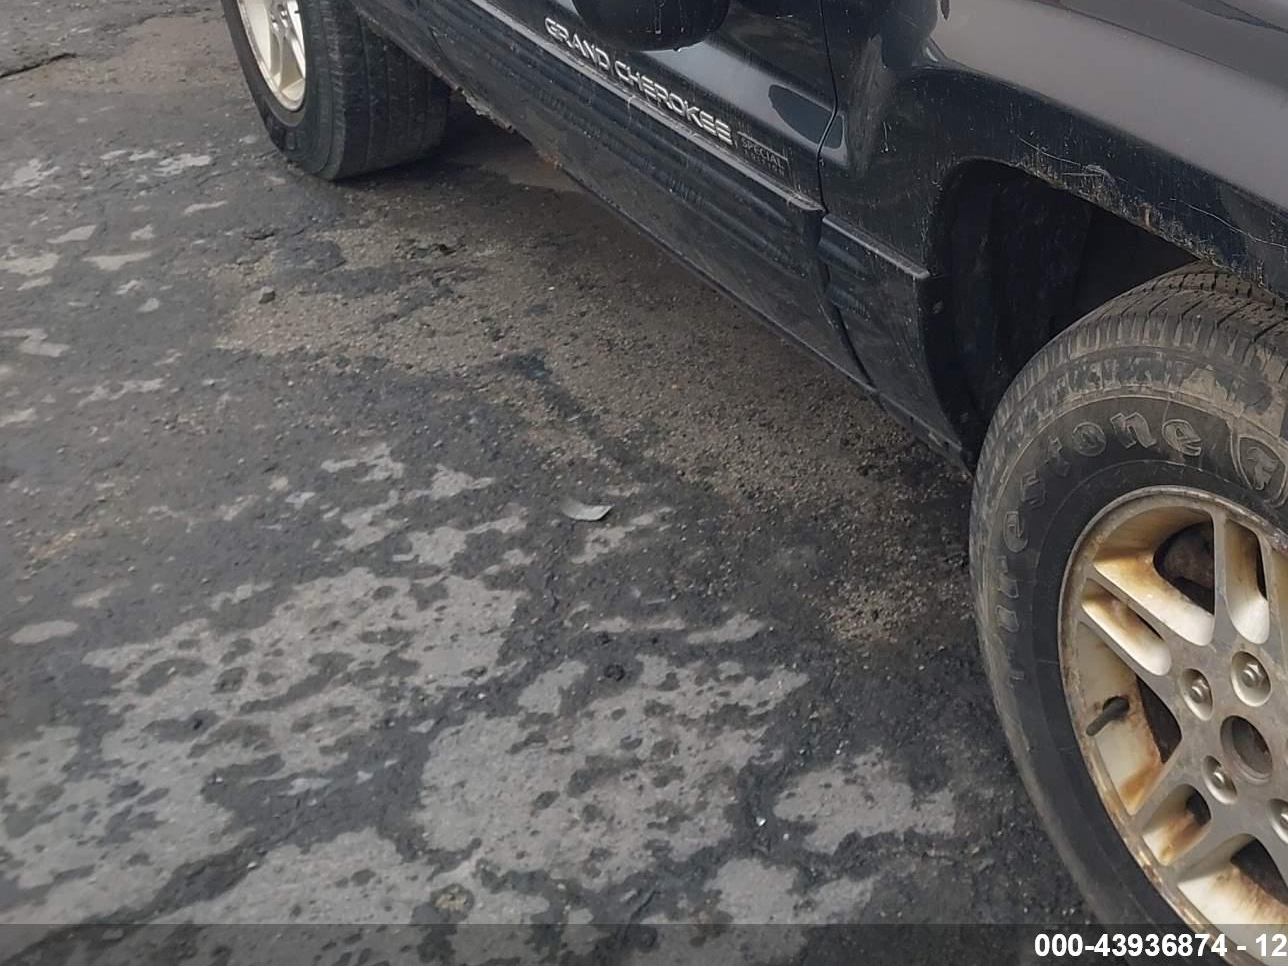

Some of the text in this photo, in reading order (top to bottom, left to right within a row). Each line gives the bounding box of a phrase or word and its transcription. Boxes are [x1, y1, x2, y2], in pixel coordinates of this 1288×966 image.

[544, 17, 733, 146] GRAND CHEROKEE
[741, 137, 785, 170] SPECIAL
